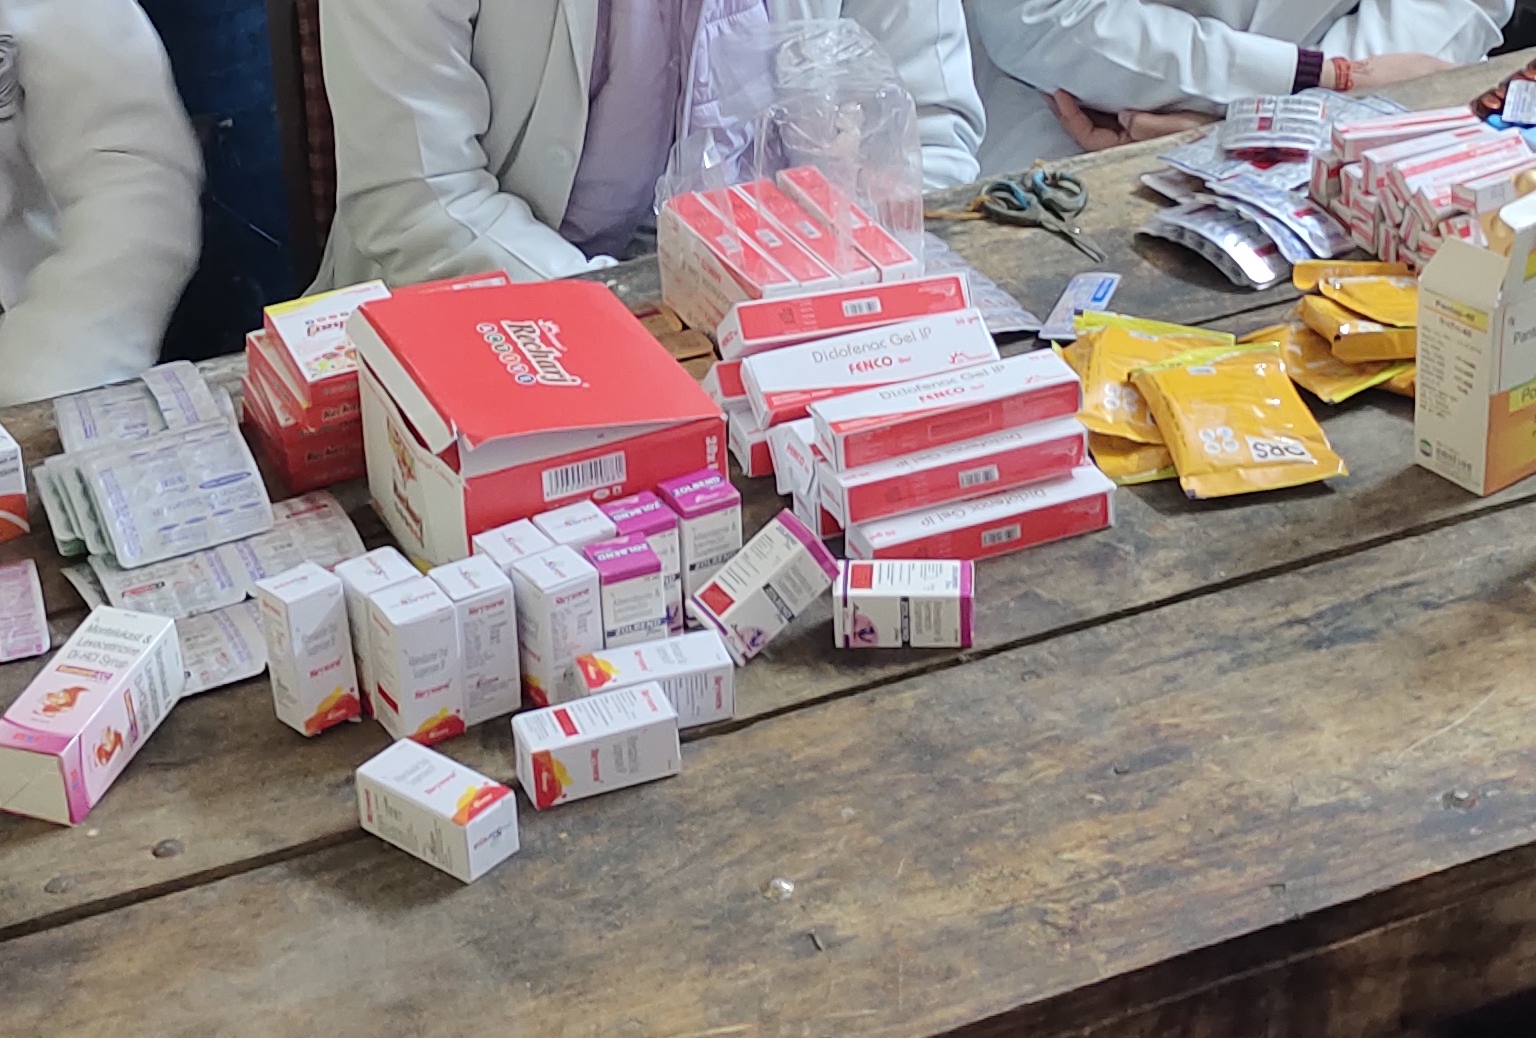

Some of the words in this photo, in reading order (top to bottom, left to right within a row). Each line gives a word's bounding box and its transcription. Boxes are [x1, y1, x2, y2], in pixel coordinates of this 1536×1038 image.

[812, 338, 887, 364] Diclofenac
[889, 331, 916, 346] Gel
[920, 326, 932, 340] IP
[849, 356, 892, 374] FENCO
[878, 378, 958, 400] Diclofenac
[960, 368, 989, 381] Gel
[918, 386, 965, 402] FENCO
[673, 476, 722, 496] ZOLBEND
[970, 488, 1047, 510] Diclofenac
[612, 500, 662, 521] ZOLBEND
[938, 505, 966, 520] Gel
[597, 542, 649, 562] ZOLBEND
